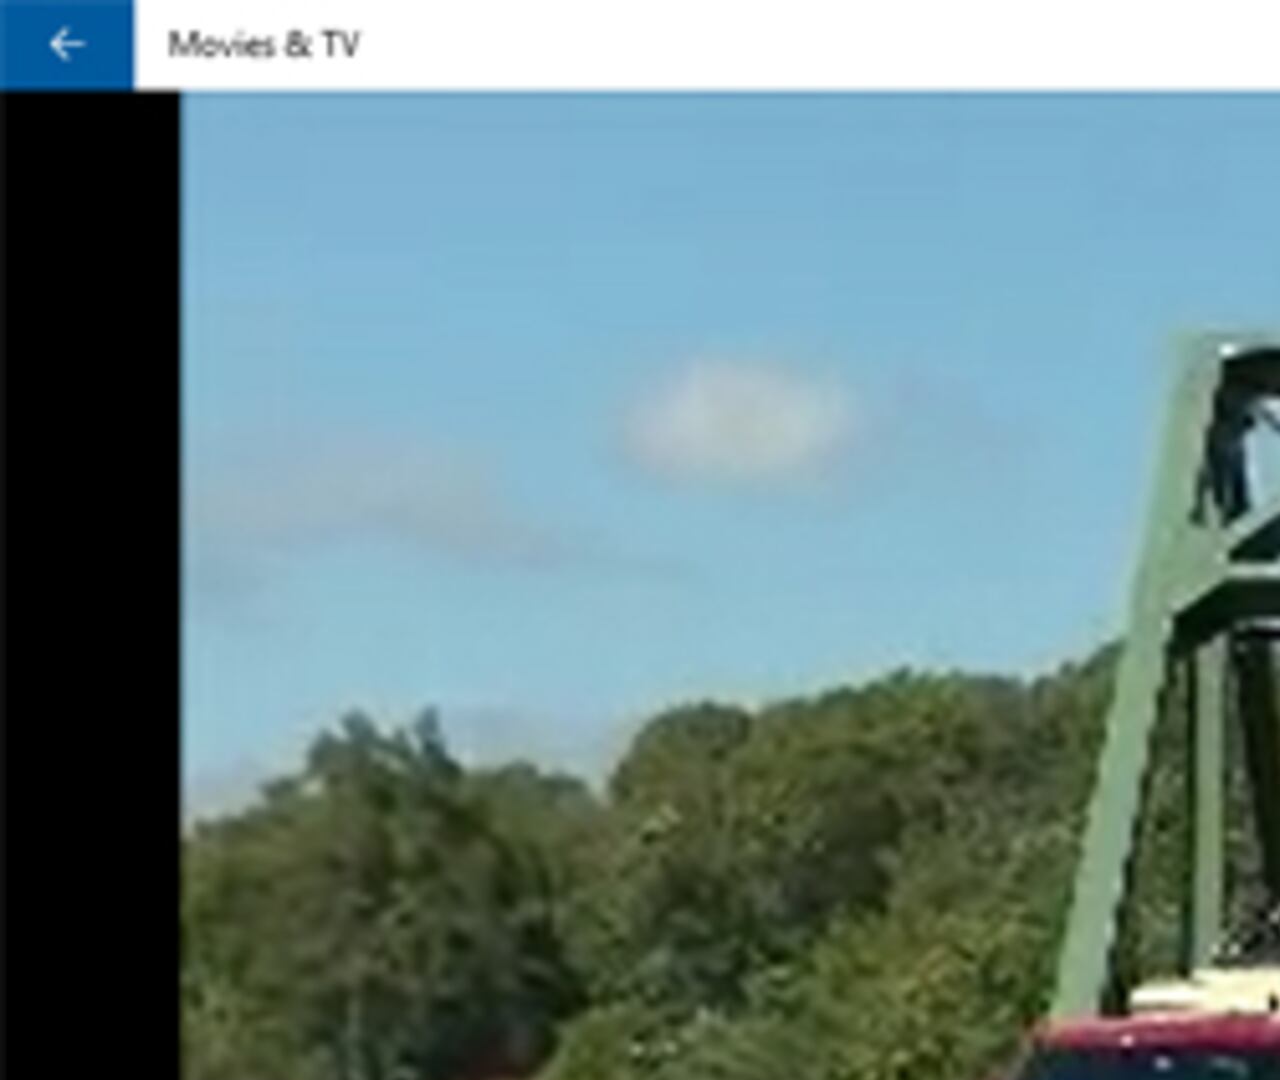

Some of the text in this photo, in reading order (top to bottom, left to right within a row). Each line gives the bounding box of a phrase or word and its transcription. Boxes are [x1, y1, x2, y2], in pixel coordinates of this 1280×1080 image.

[169, 29, 361, 59] Movies & TV
